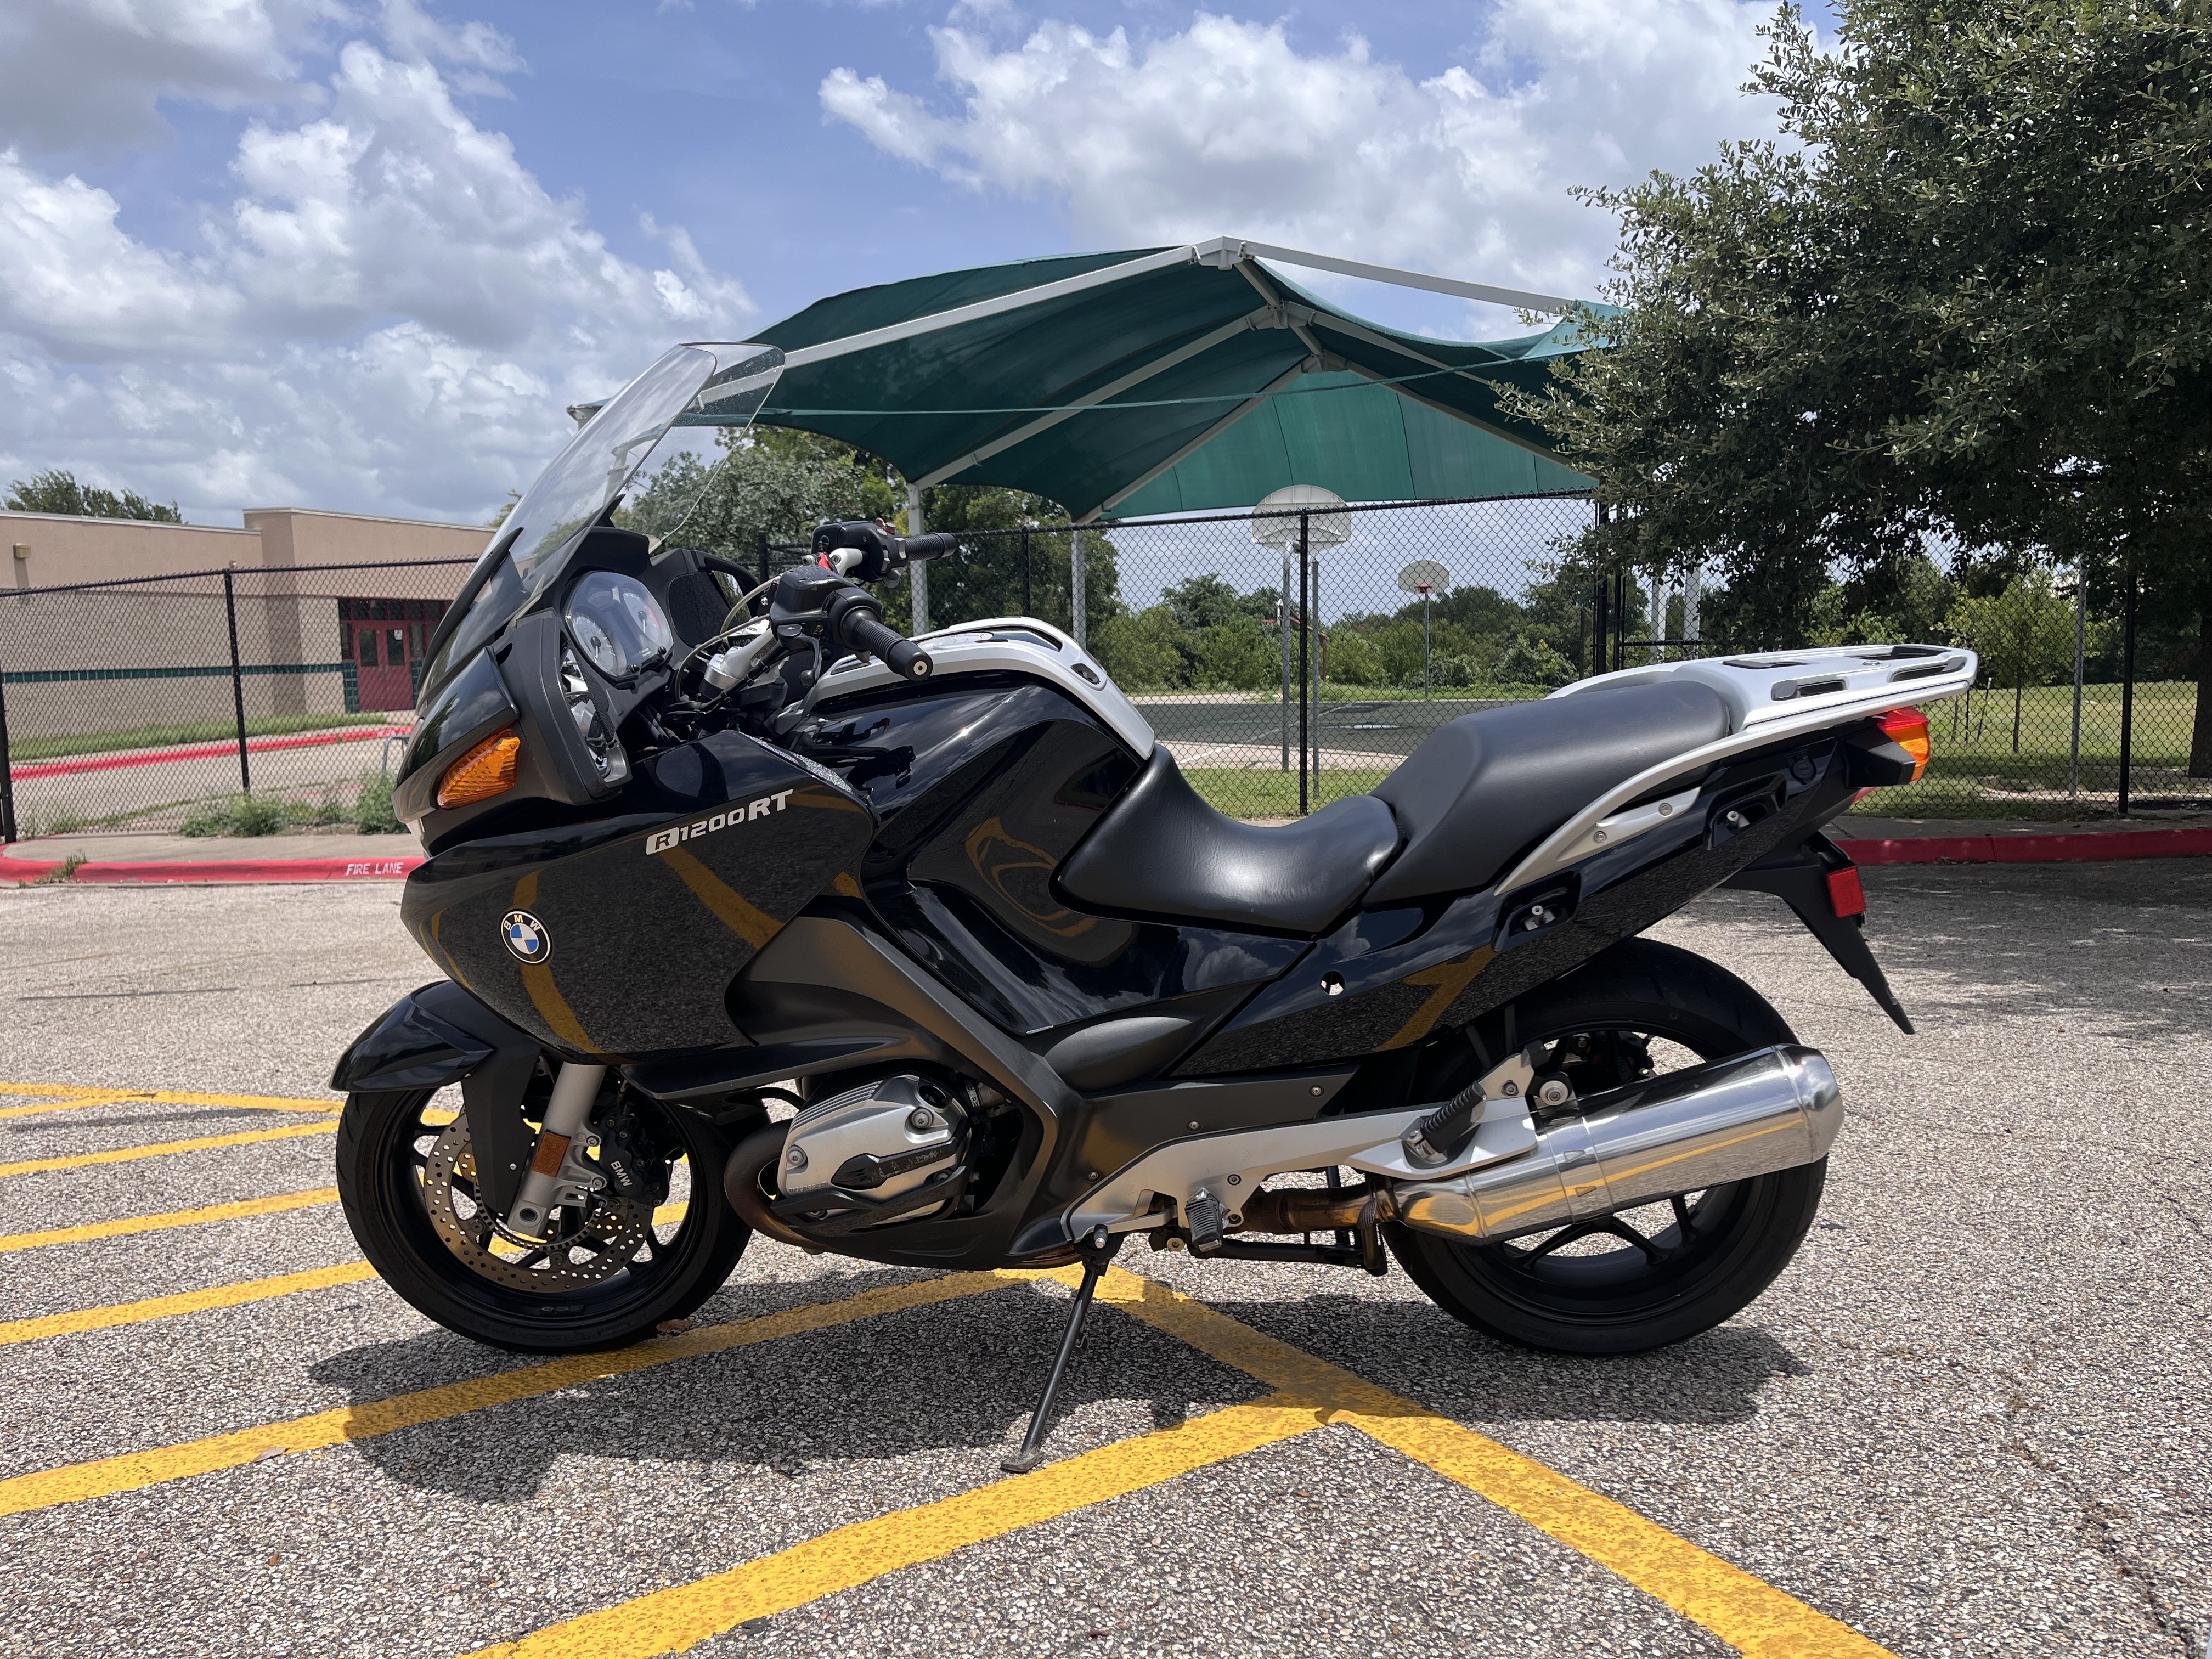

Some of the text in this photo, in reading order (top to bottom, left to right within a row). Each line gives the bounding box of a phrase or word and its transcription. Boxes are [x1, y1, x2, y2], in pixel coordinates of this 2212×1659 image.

[646, 788, 793, 855] R1200RT
[346, 861, 404, 876] FIRE LANE
[503, 914, 540, 931] BMW
[611, 1160, 633, 1186] BMW
